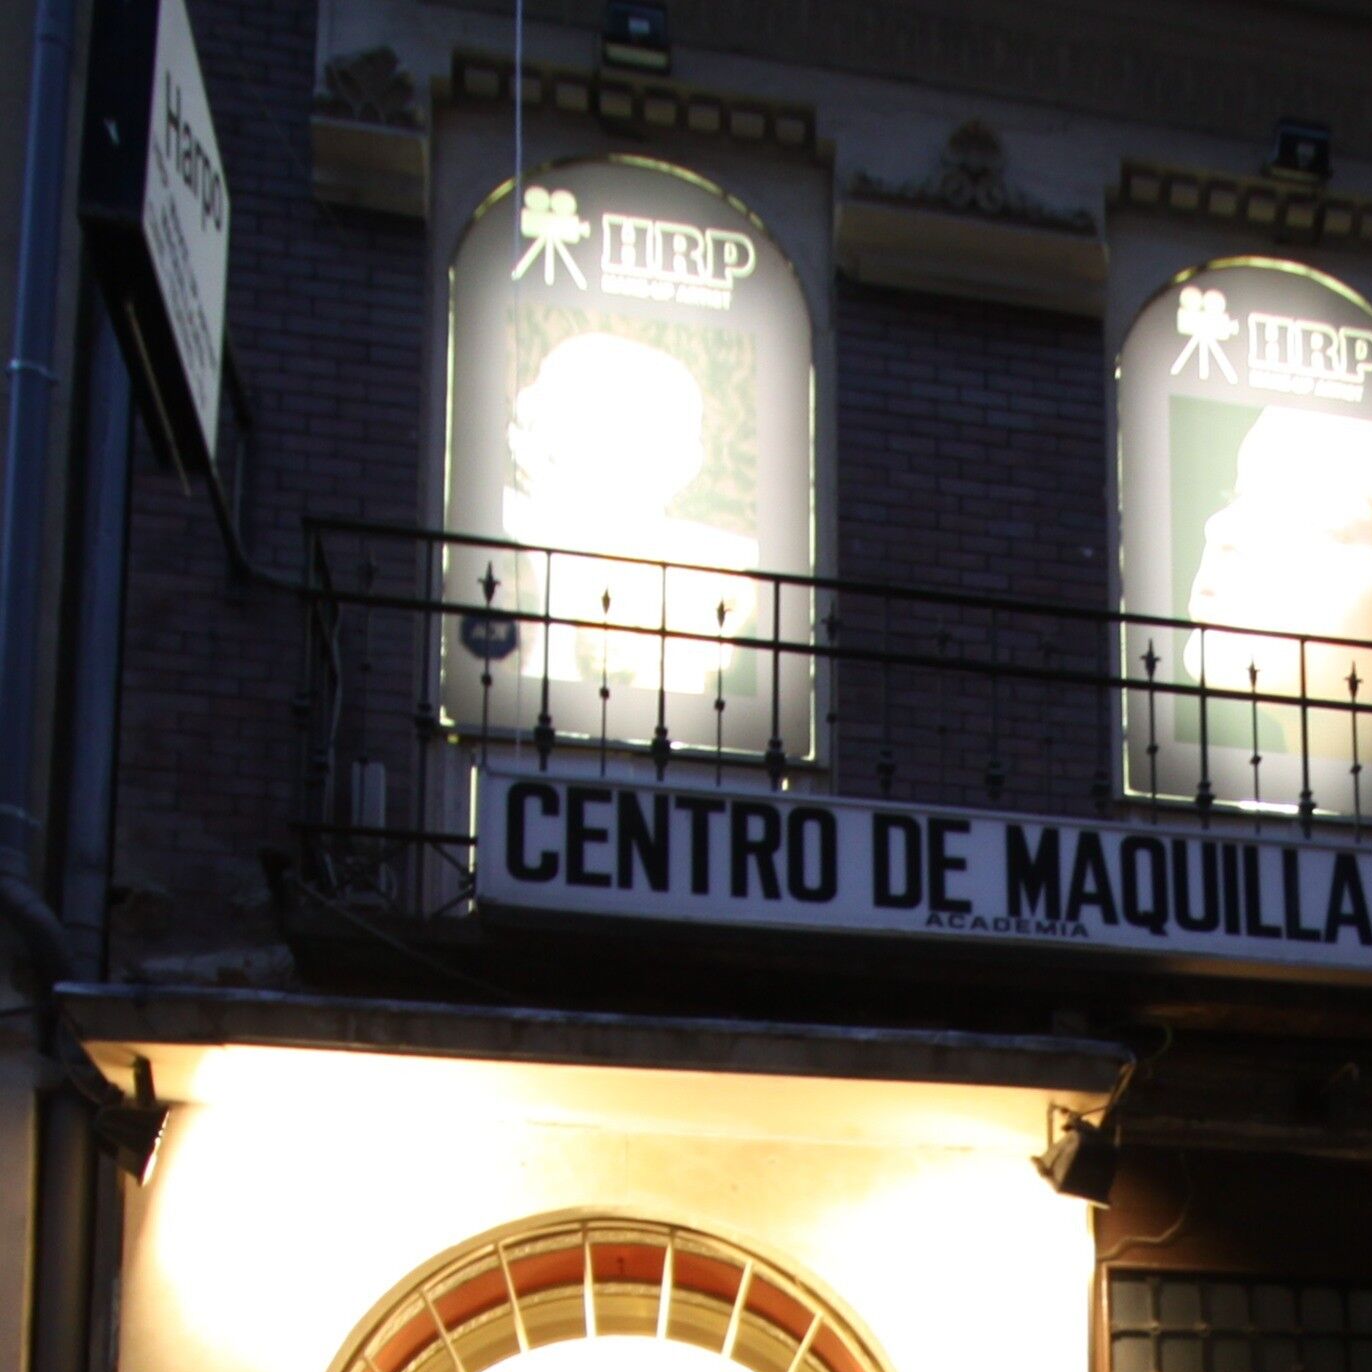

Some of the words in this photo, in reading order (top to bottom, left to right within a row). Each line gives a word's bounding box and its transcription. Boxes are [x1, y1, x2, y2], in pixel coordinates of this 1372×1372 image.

[165, 69, 223, 232] Harpo
[602, 214, 755, 290] HRP
[506, 781, 838, 903] CENTRO
[872, 812, 973, 914] DE
[925, 913, 1089, 938] ACADEMIA
